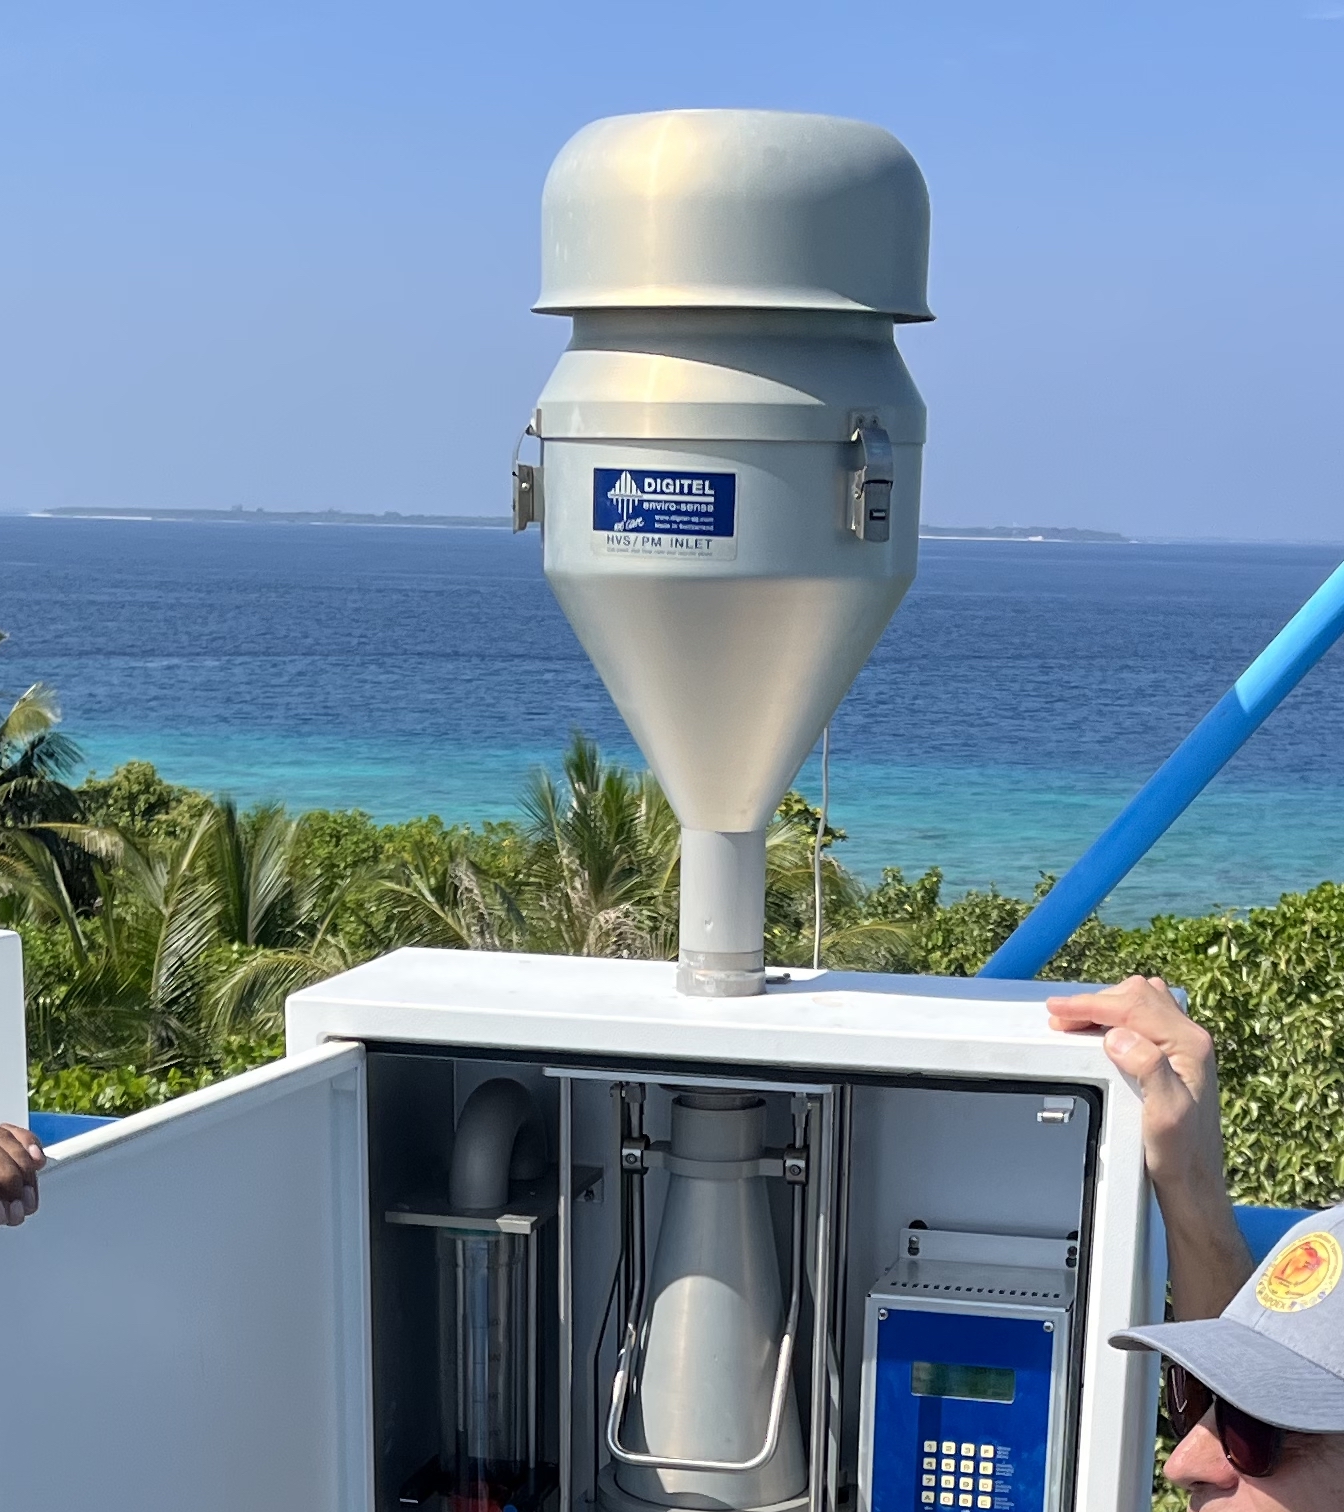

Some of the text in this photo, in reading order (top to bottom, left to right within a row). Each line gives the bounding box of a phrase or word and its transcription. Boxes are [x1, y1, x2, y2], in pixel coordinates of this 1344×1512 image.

[644, 477, 714, 494] DIGITEL
[643, 501, 714, 512] enviro-sense
[670, 538, 713, 549] INLET
